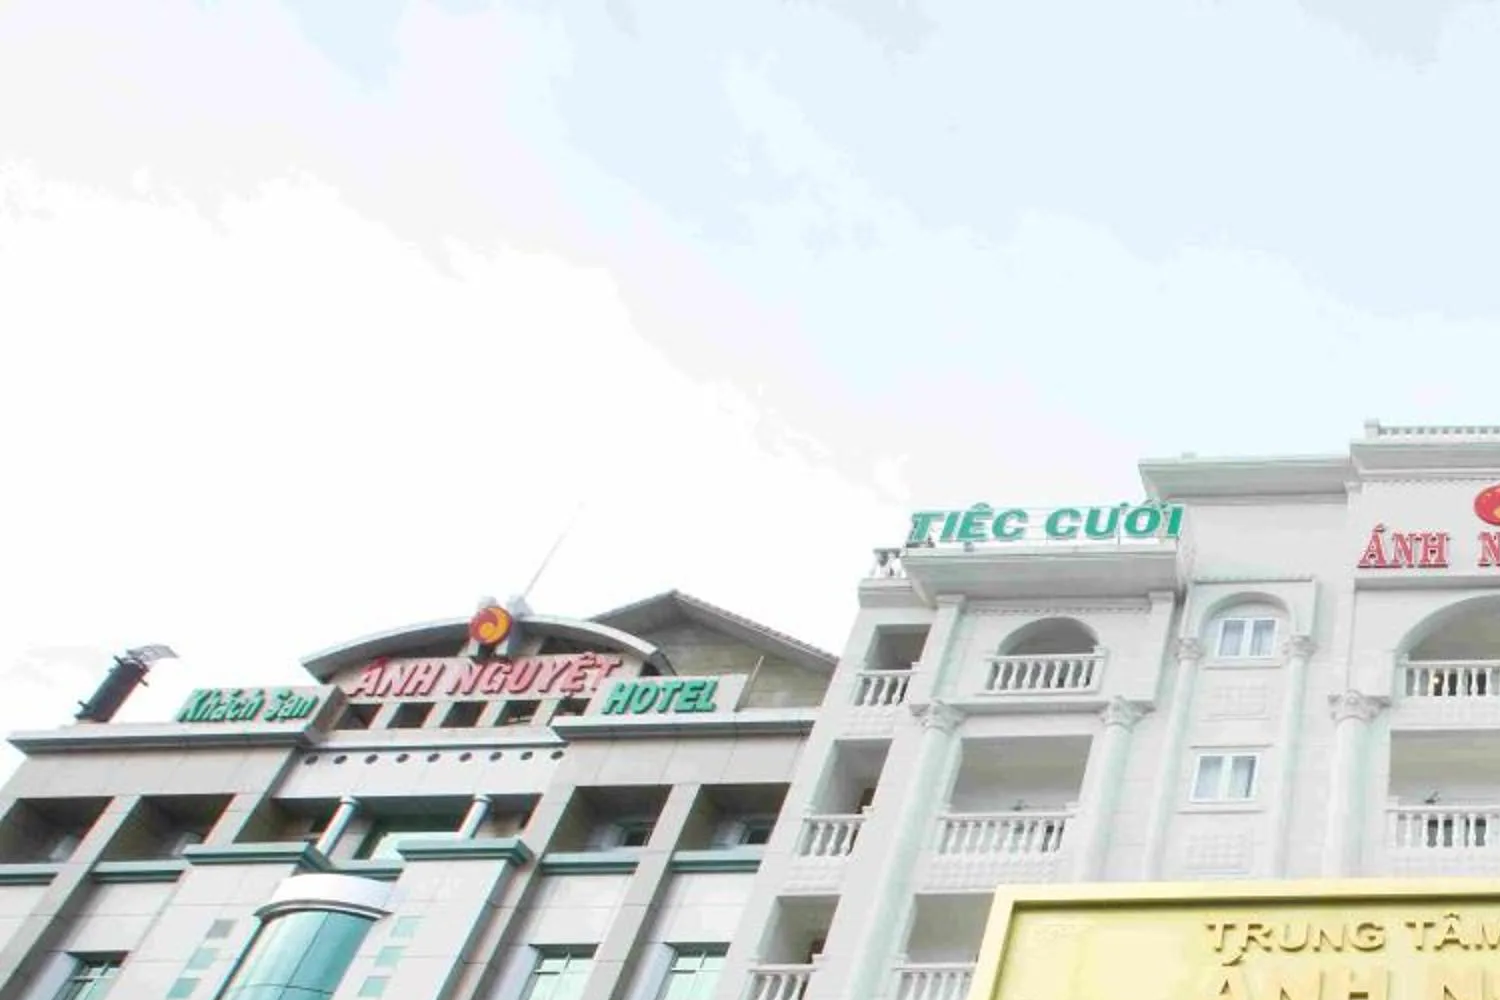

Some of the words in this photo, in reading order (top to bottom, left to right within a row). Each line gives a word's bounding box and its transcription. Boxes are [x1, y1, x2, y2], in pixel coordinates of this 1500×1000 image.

[907, 502, 1030, 552] TIỆC
[1357, 523, 1450, 569] ÁNH
[347, 656, 442, 697] ÁNH
[177, 686, 265, 723] Khách
[602, 679, 718, 715] HOTEL
[1205, 921, 1387, 952] TRUNG
